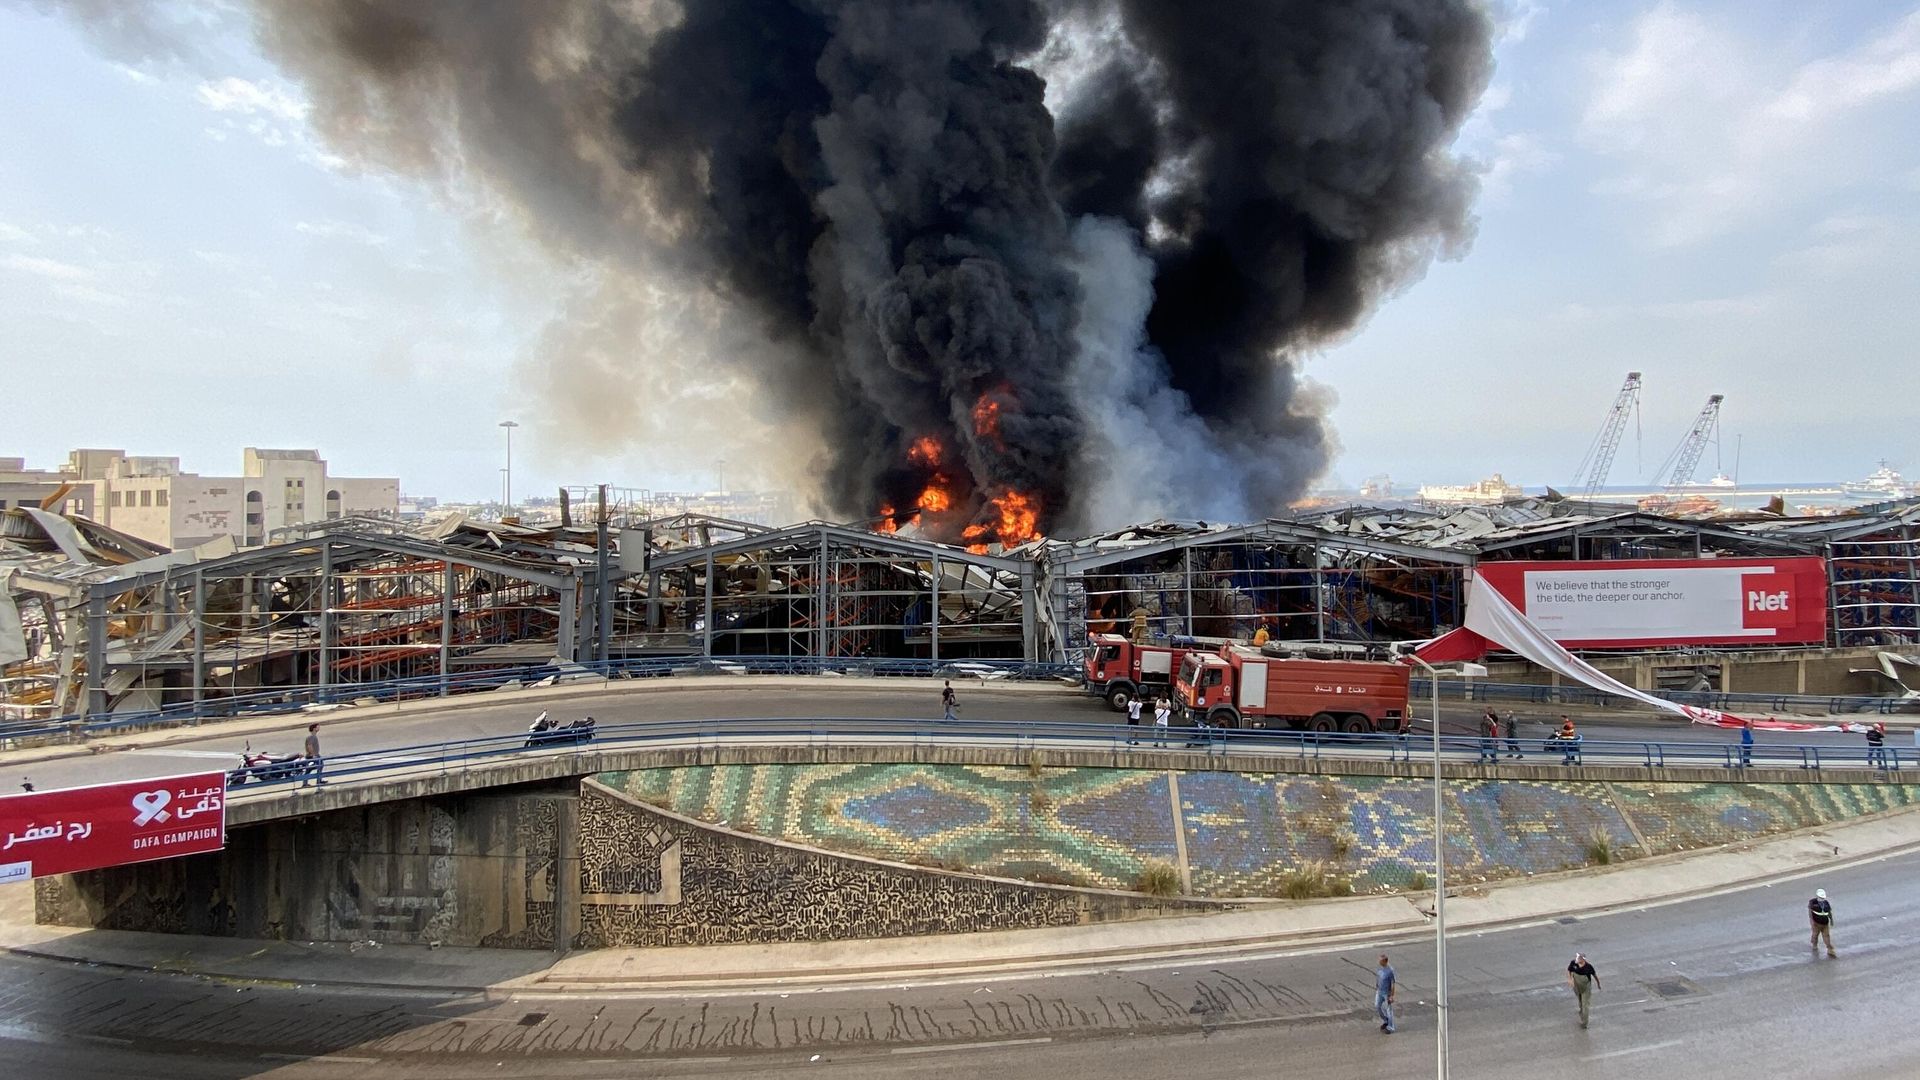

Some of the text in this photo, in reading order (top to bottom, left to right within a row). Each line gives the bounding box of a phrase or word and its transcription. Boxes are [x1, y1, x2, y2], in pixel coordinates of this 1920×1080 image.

[1536, 580, 1670, 591] We believe that the stronger
[1537, 591, 1686, 603] the tide, the deeper our anchor.
[1749, 591, 1789, 611] Net
[178, 787, 222, 799] حملة
[67, 822, 92, 841] رح
[133, 827, 218, 849] DAFA CAMPAIGN
